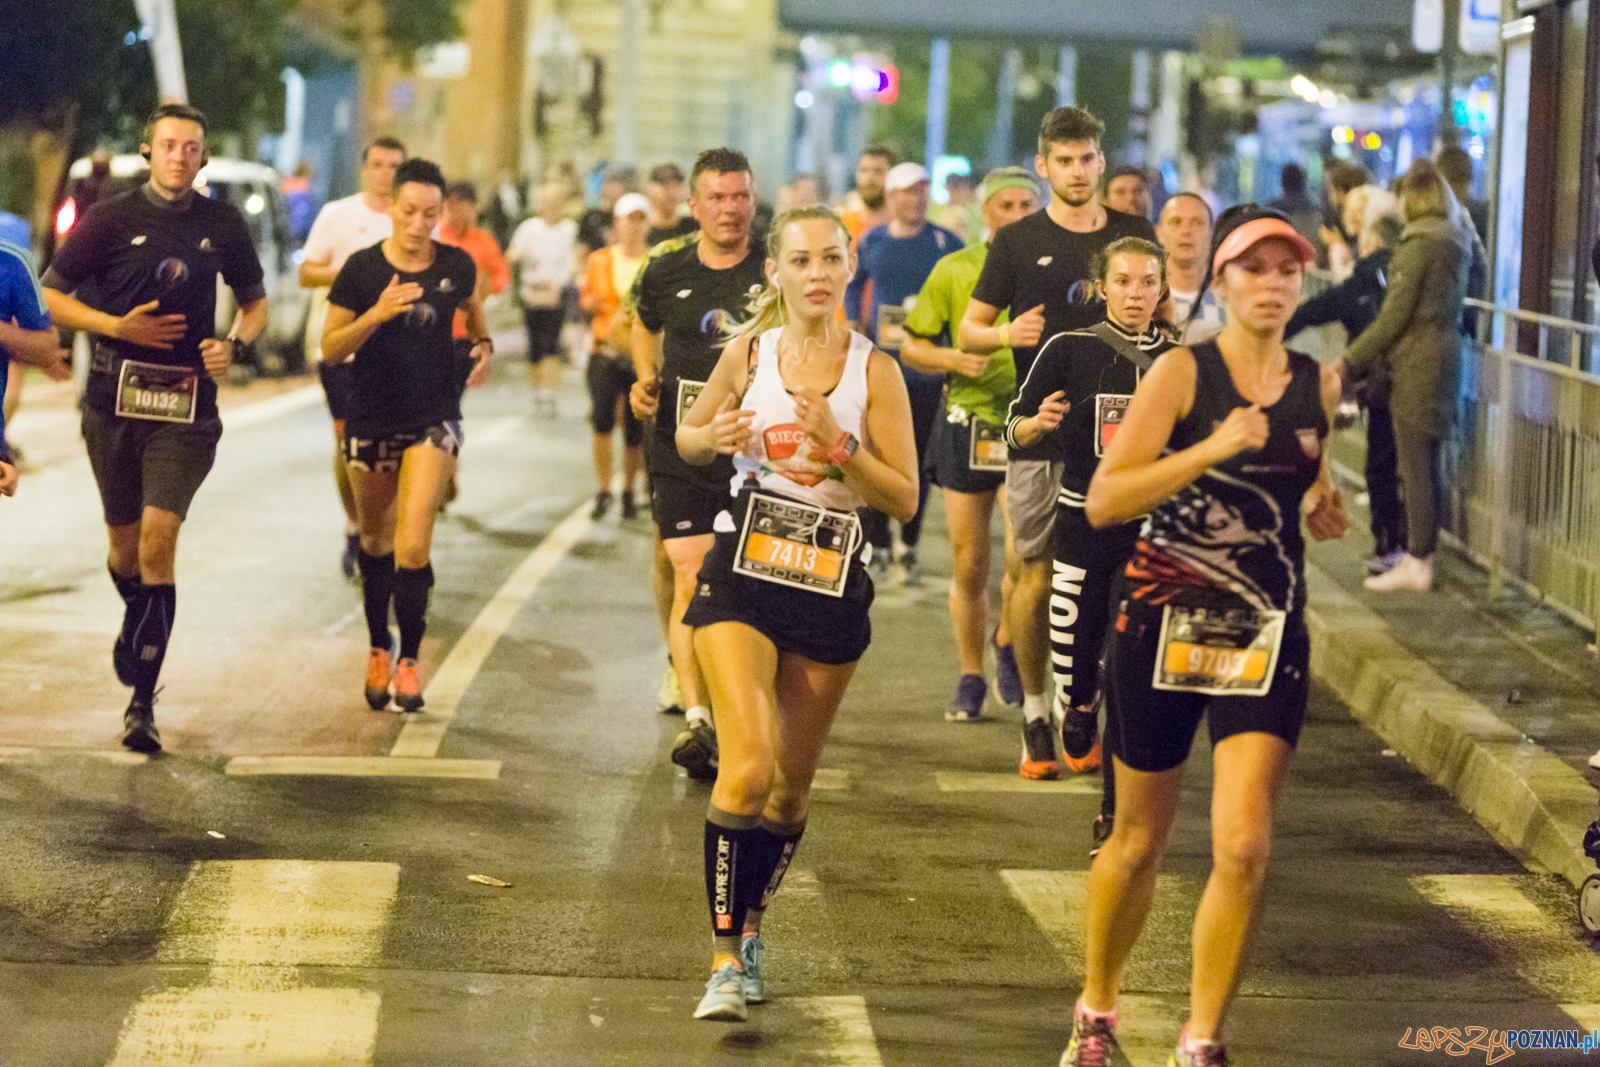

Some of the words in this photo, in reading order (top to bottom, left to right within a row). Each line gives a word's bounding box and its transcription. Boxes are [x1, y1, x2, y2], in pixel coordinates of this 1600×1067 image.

[135, 389, 179, 410] 10132
[770, 539, 817, 571] 7413
[1188, 647, 1246, 676] 9703
